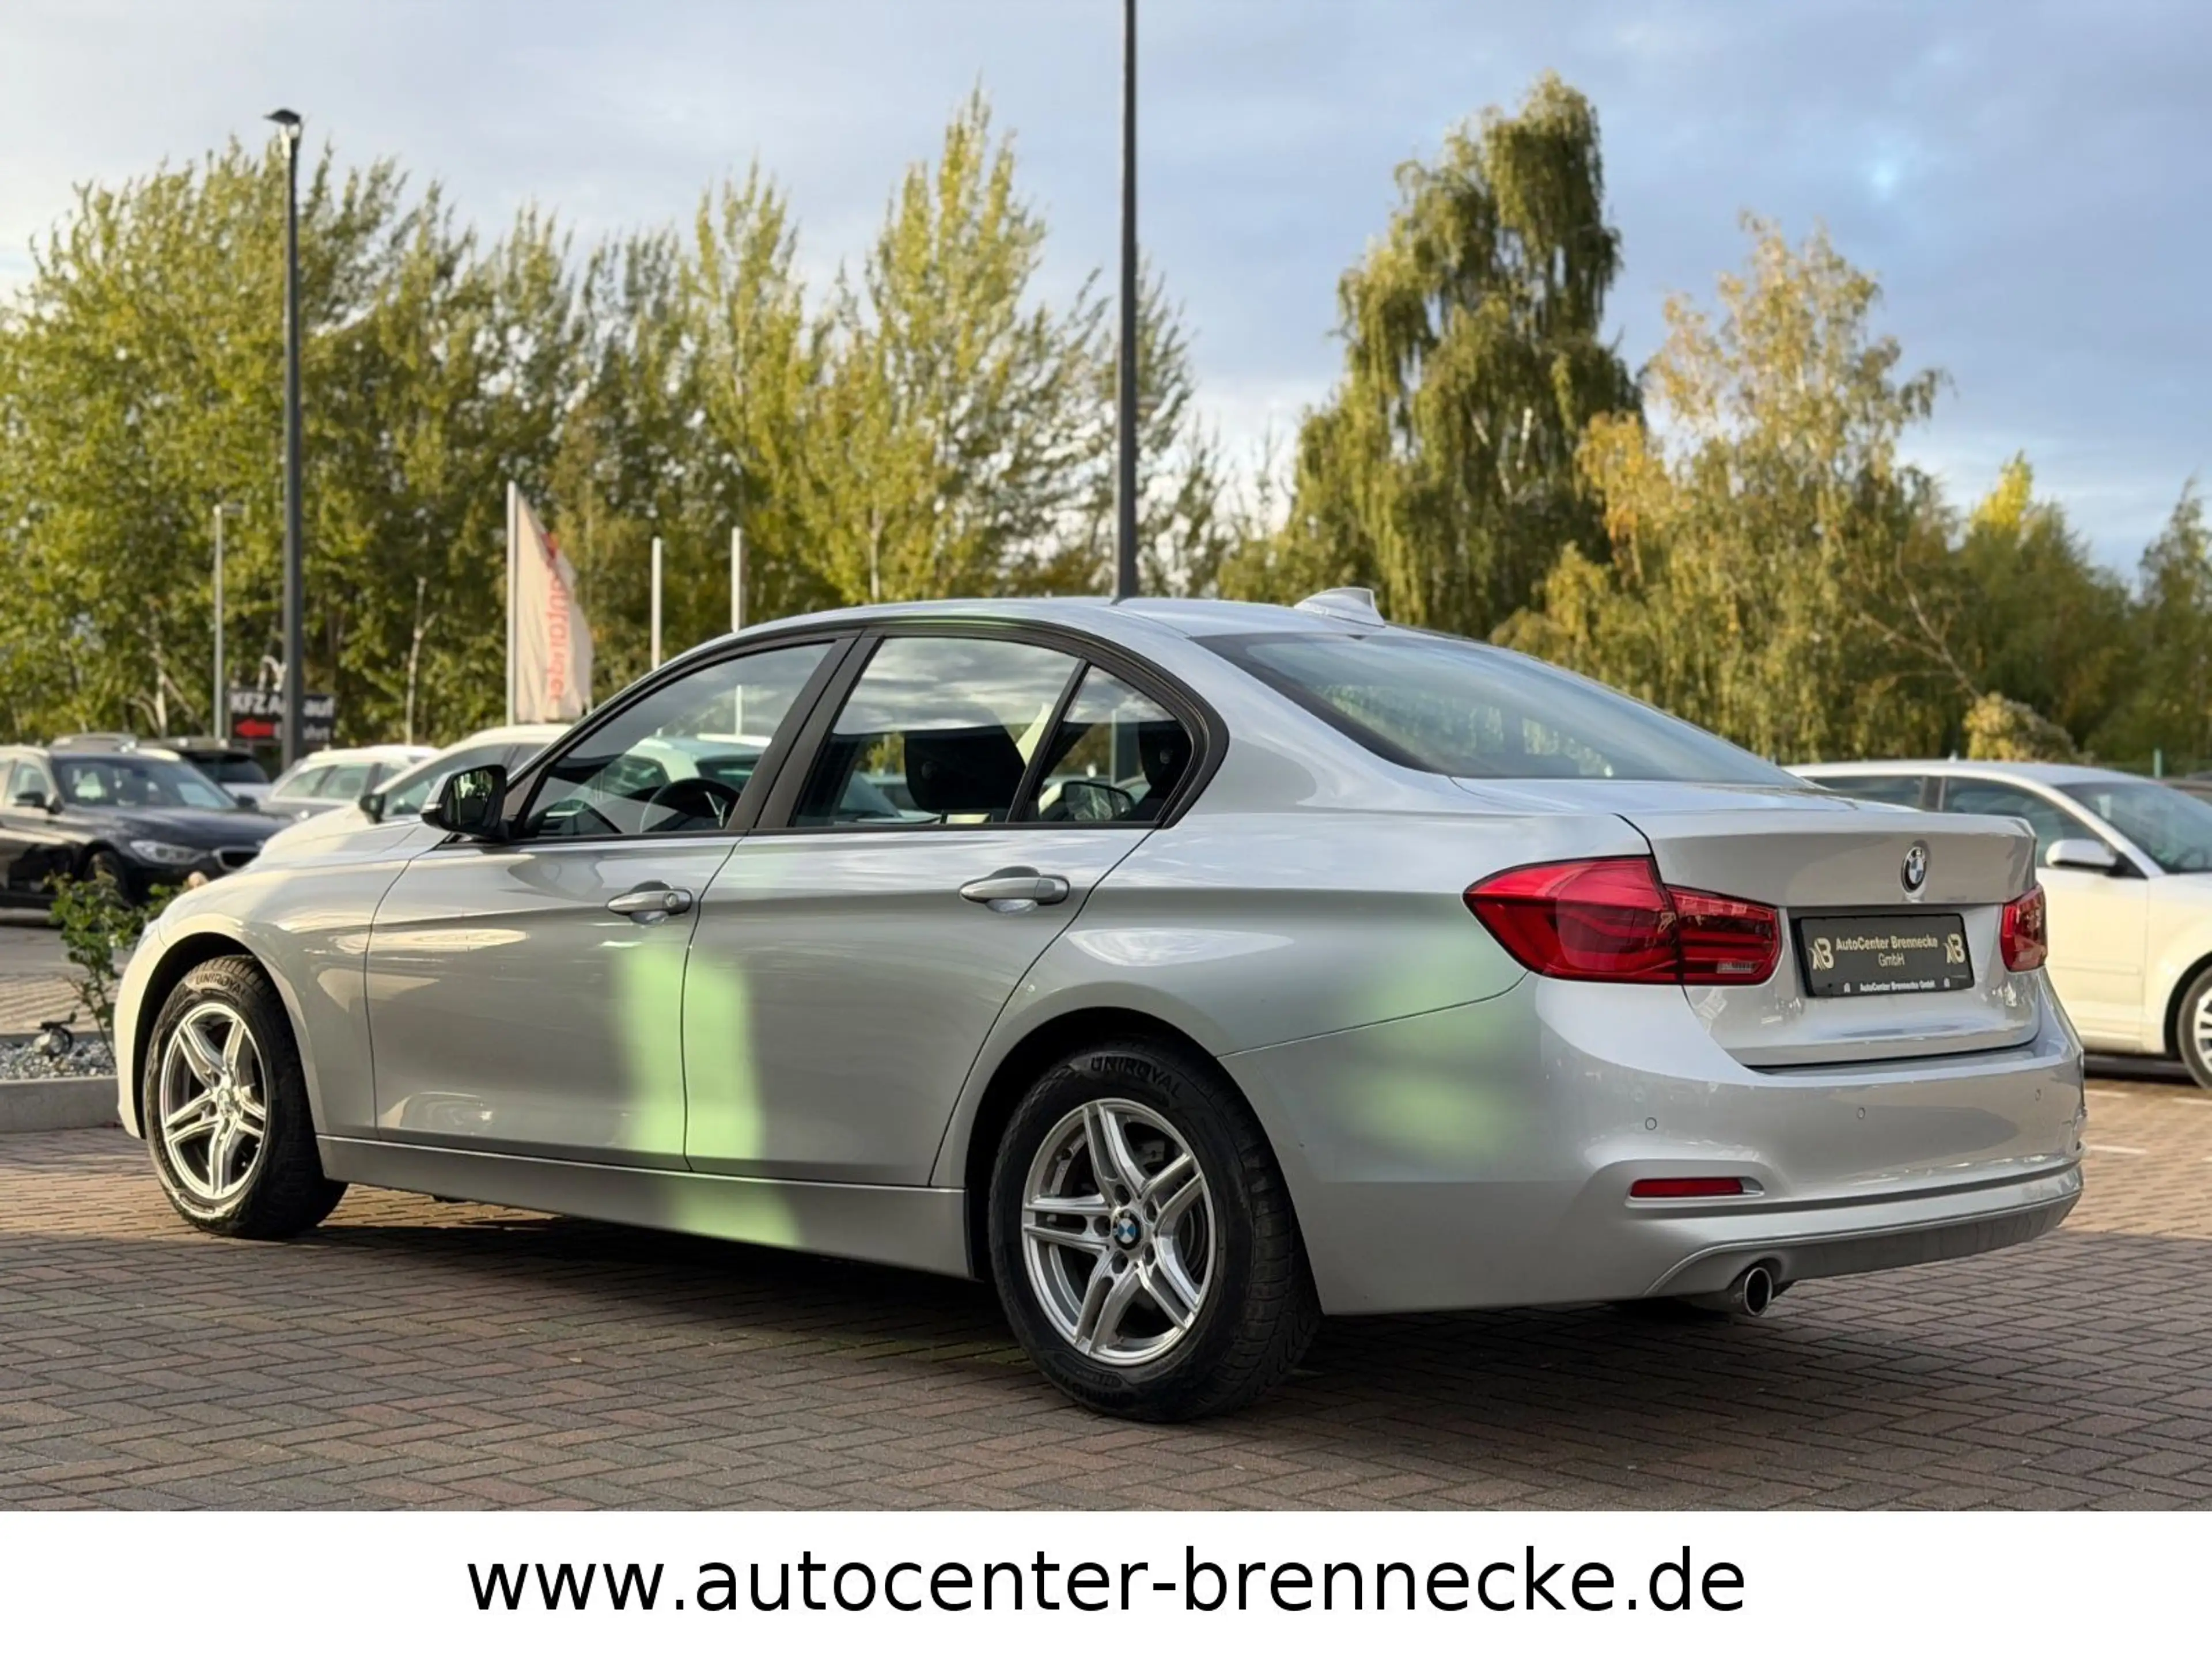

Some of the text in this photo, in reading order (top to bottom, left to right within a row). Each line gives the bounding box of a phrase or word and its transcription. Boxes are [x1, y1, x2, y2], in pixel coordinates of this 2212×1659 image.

[1835, 934, 1938, 950] AutoCenter Brennecke
[1878, 952, 1905, 967] GmbH
[1091, 1056, 1181, 1099] UNIROYAL
